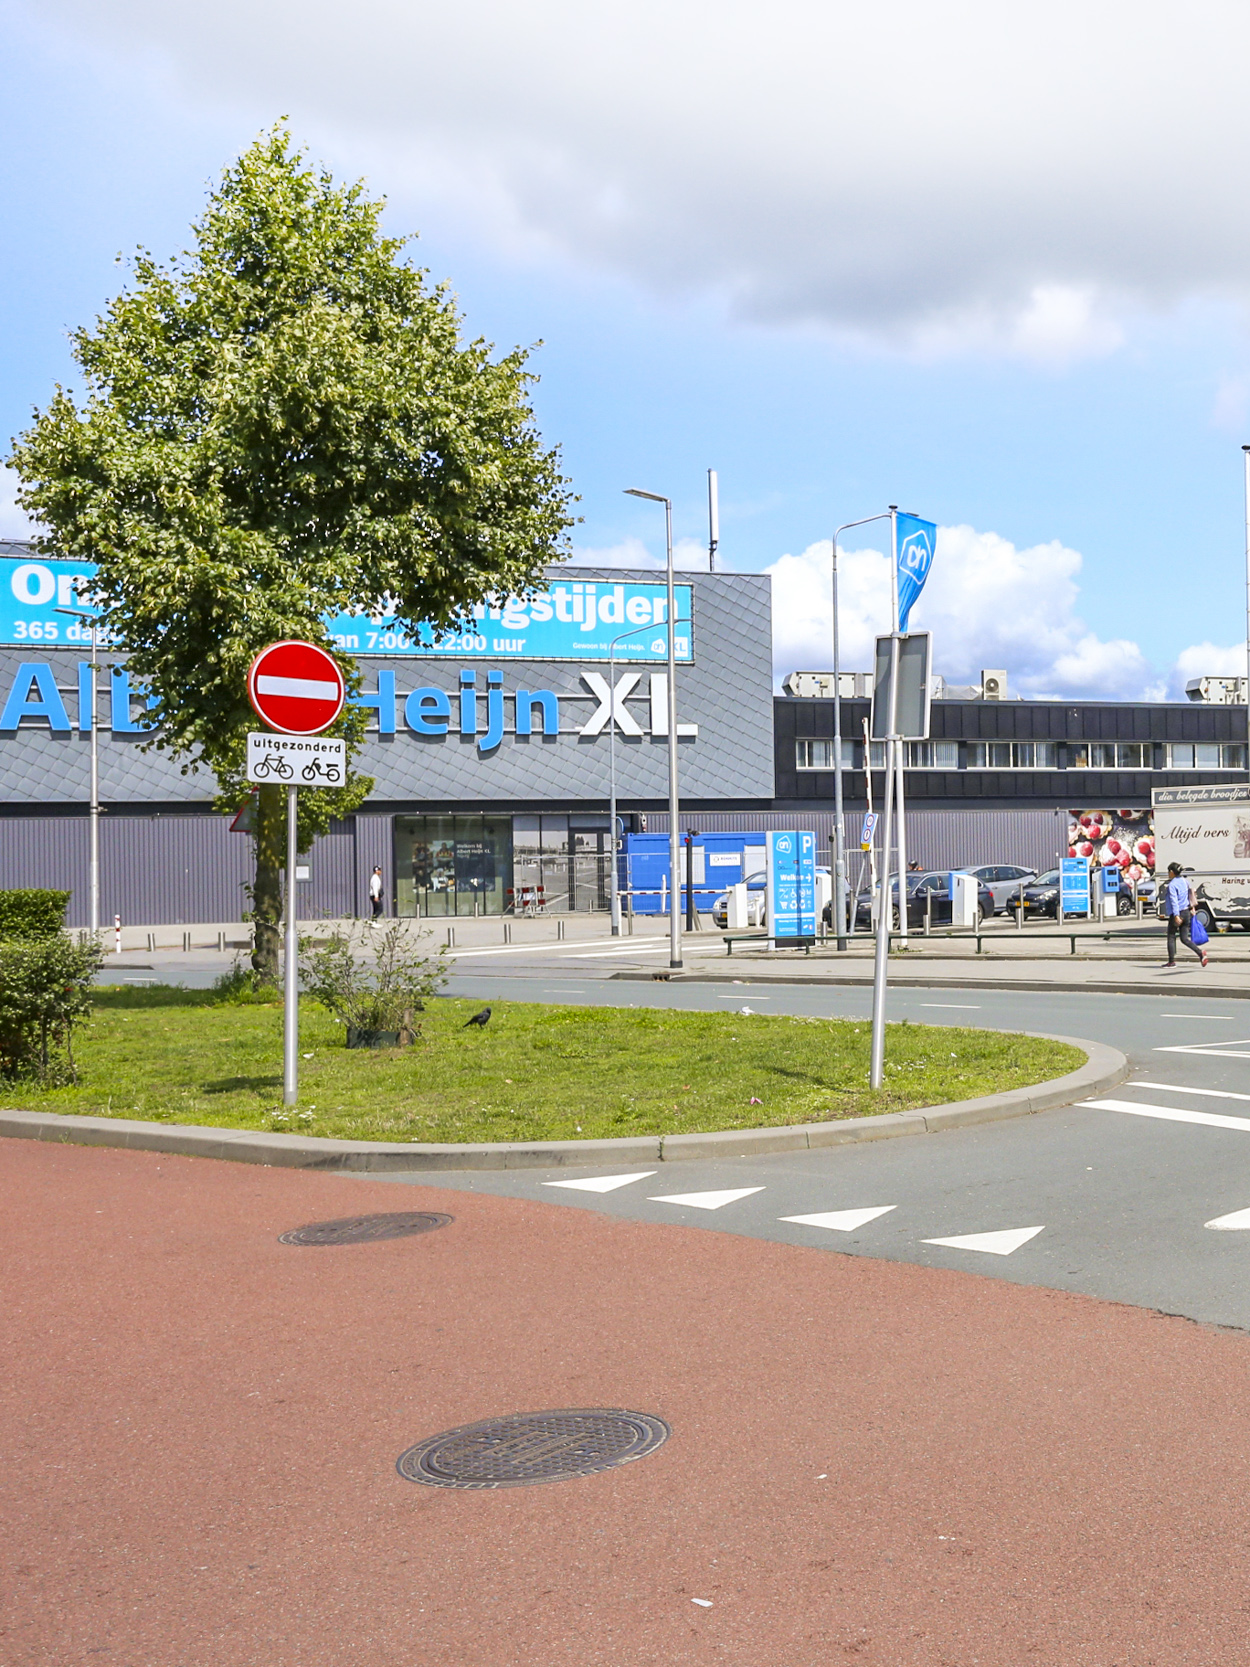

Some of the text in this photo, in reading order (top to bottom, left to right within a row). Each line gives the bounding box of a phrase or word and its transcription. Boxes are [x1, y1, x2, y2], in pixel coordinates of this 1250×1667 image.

[13, 620, 59, 640] 365
[365, 631, 410, 650] 7:00
[493, 638, 527, 652] uur
[345, 669, 560, 752] Heijn
[580, 671, 699, 736] XL
[253, 738, 341, 754] uitgezonderd
[1176, 788, 1209, 803] belegde
[1210, 787, 1248, 802] broodjes
[1161, 825, 1202, 844] Altijd
[1203, 828, 1230, 838] vers
[1221, 877, 1245, 886] Haring
